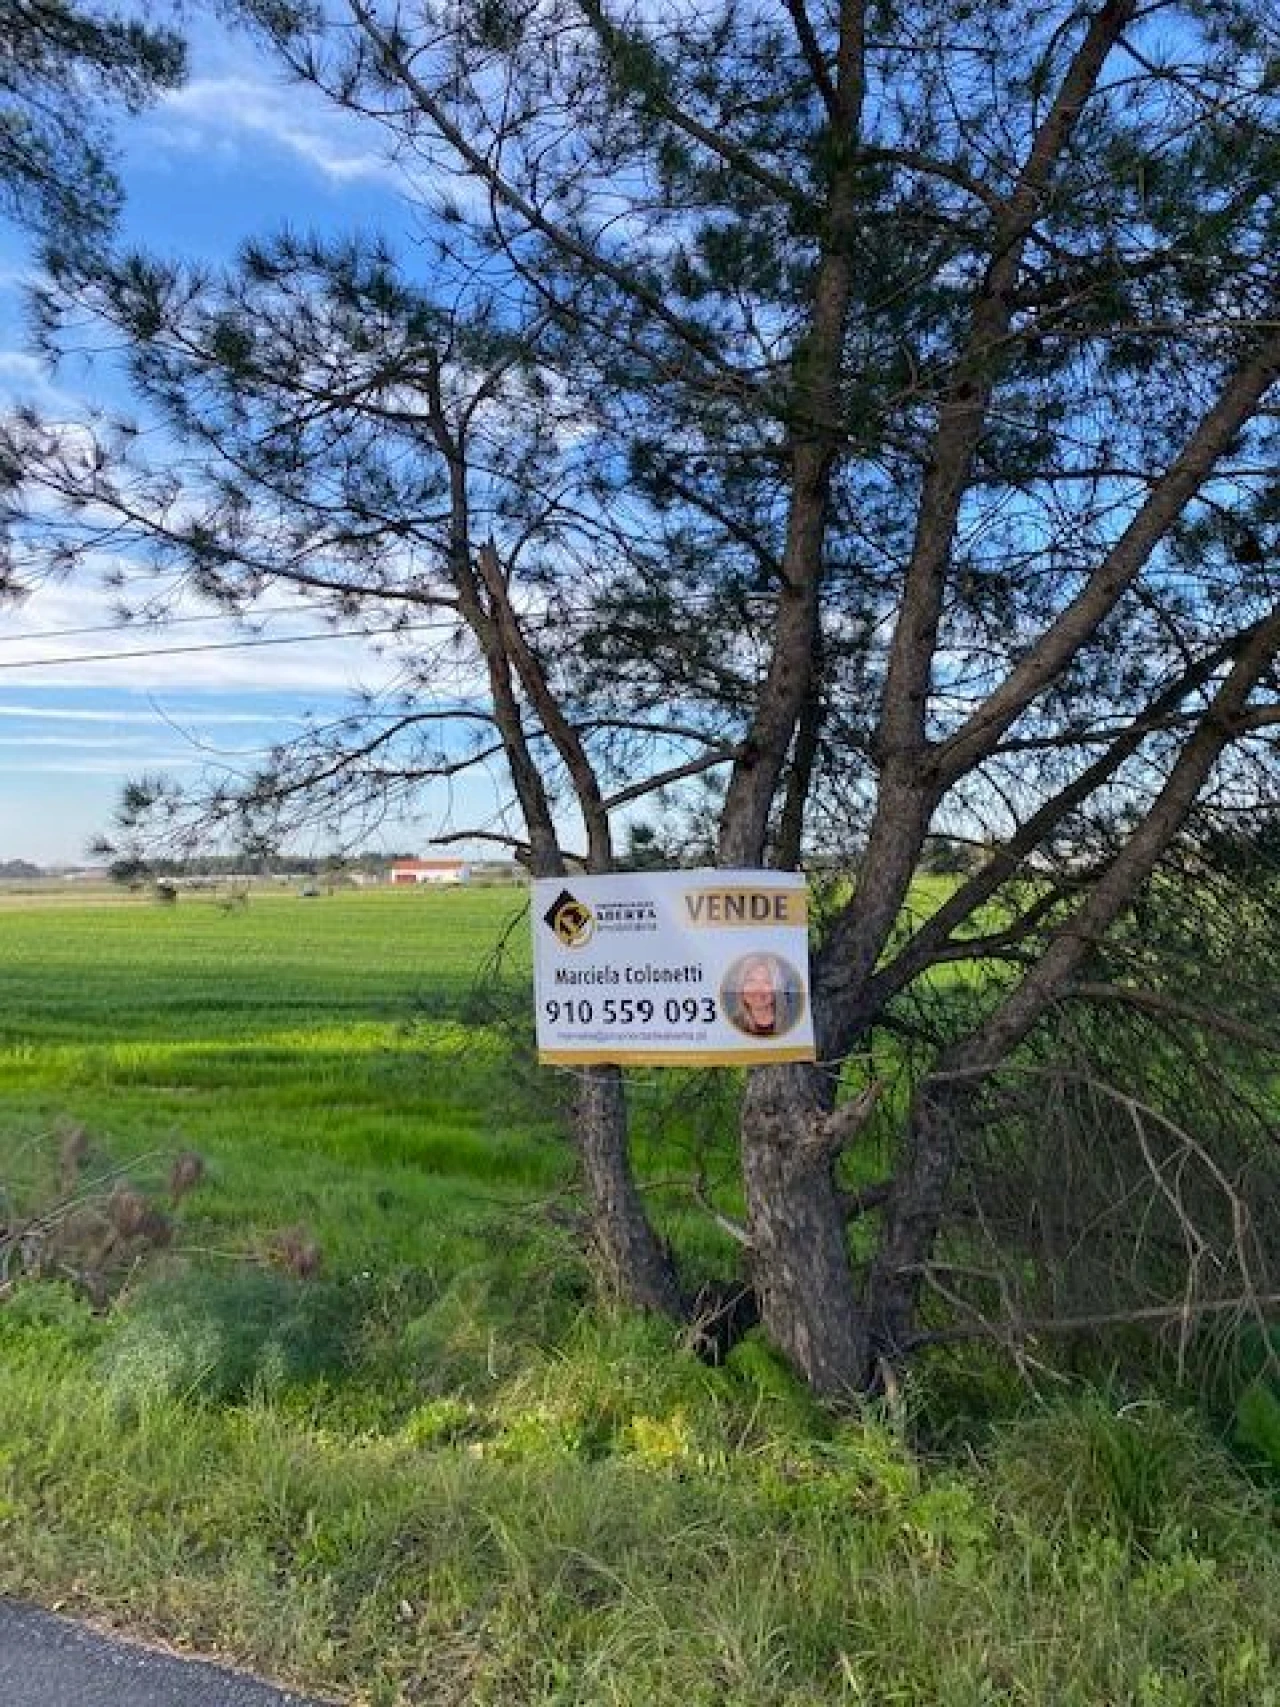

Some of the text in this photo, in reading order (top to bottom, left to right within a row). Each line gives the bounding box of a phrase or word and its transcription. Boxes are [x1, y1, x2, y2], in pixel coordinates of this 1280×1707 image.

[685, 894, 788, 921] VENDE
[555, 963, 702, 985] Marciela Colonetti
[546, 998, 718, 1024] 910 559 093
